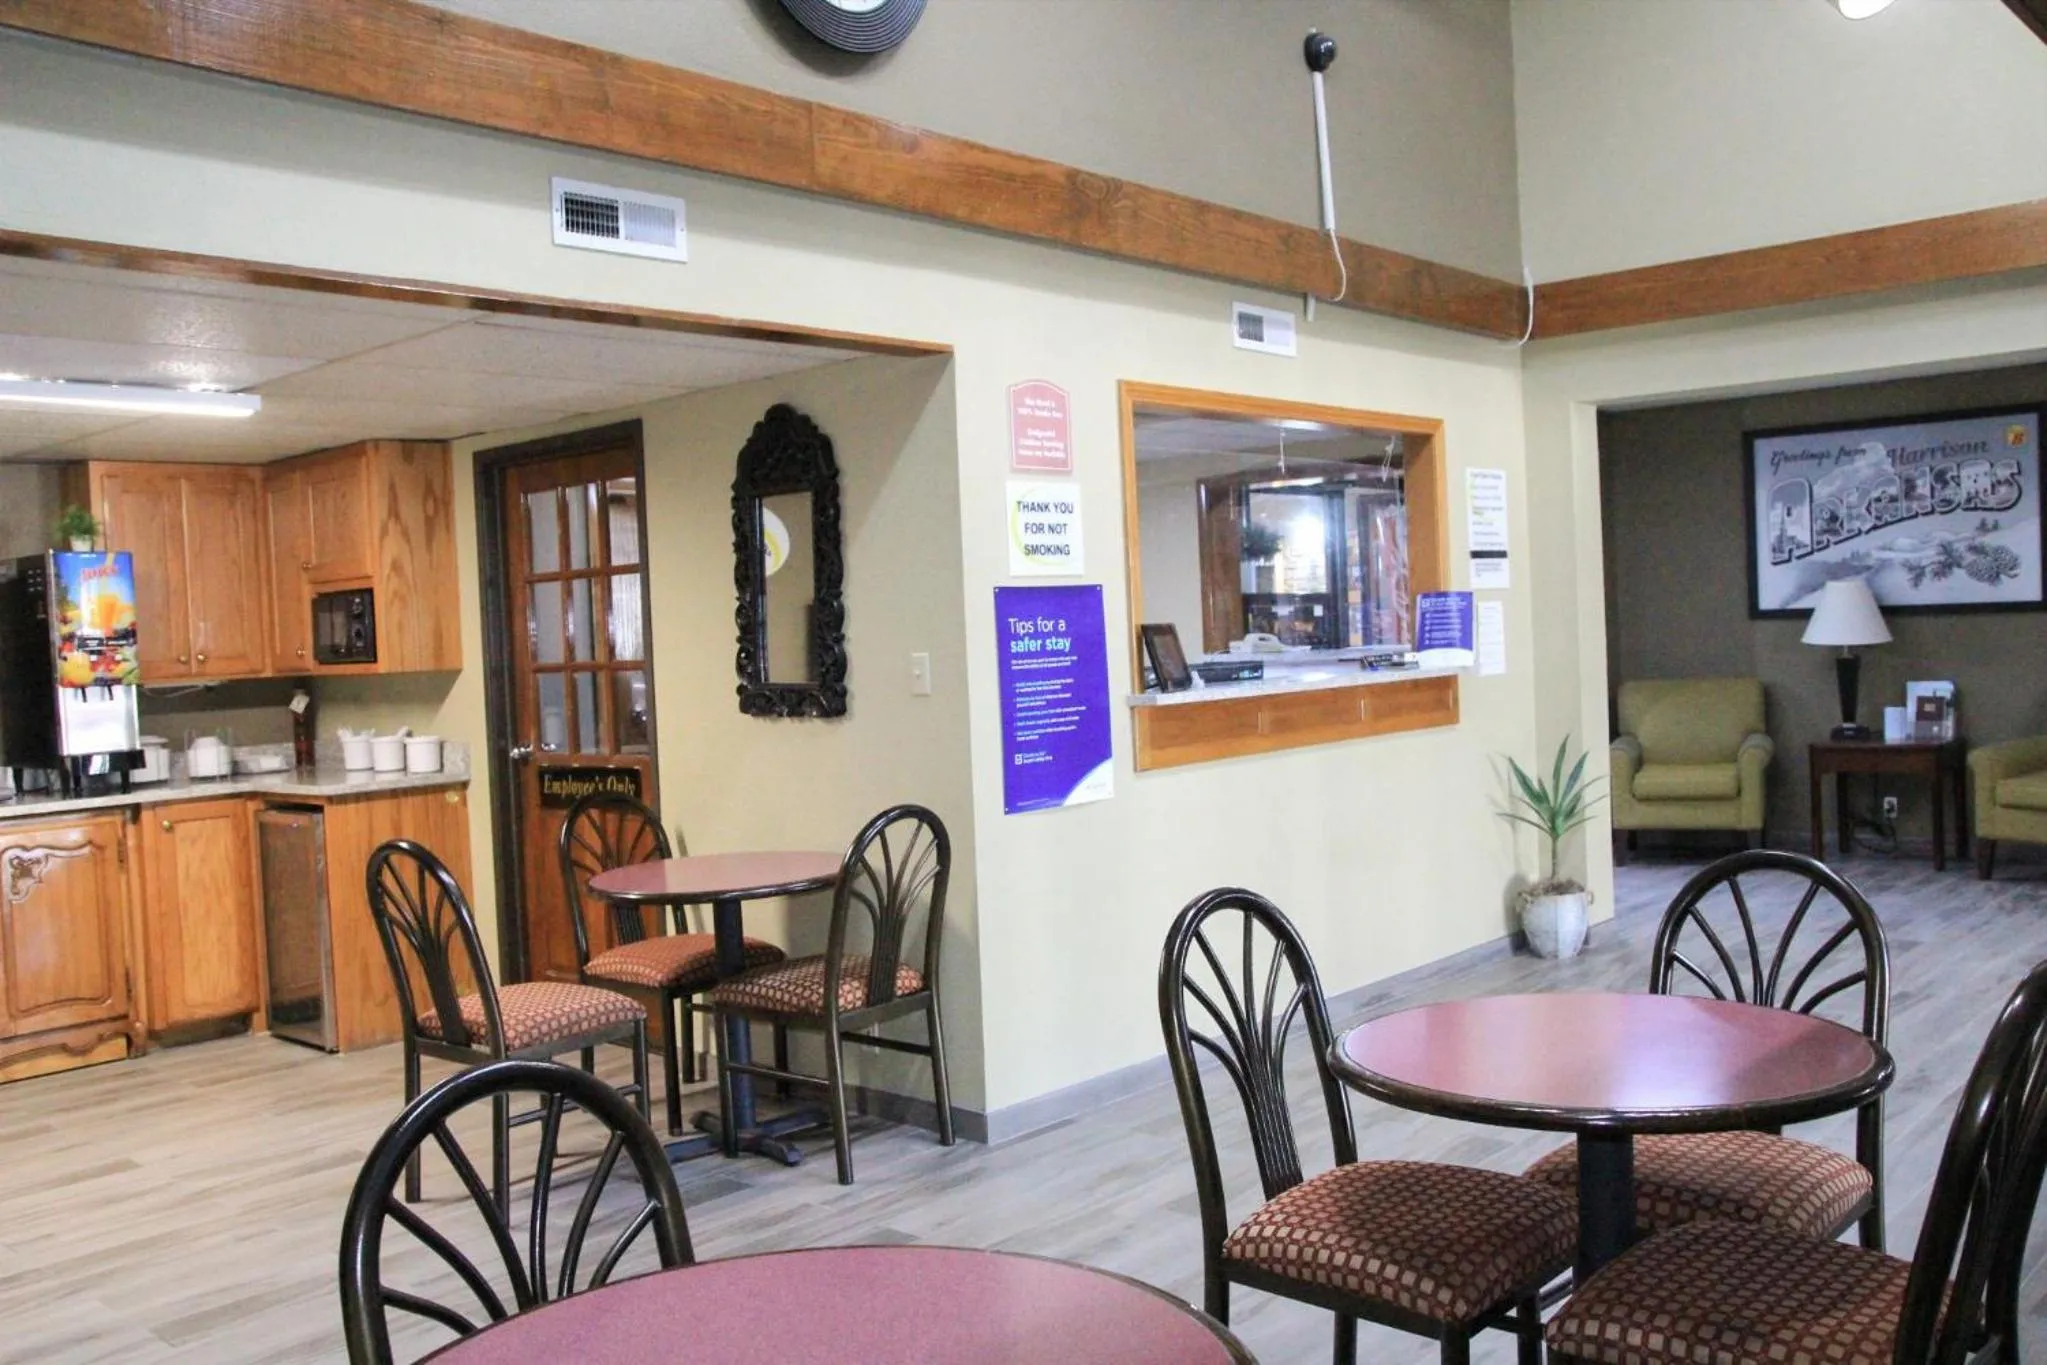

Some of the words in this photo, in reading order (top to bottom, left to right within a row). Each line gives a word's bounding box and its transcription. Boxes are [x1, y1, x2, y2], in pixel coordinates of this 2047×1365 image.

[1770, 448, 1831, 475] Greetings
[1834, 445, 1867, 466] from
[1886, 440, 1989, 468] Harrison
[1016, 500, 1051, 514] THANK
[1052, 501, 1074, 515] YOU
[1768, 458, 2023, 566] ARKANSAS
[1024, 522, 1045, 535] FOR
[1047, 523, 1068, 535] NOT
[1023, 543, 1071, 556] SMOKING
[1008, 617, 1034, 636] Tips
[1036, 616, 1055, 632] for
[1058, 619, 1066, 632] a
[1010, 636, 1042, 653] safer
[1046, 636, 1072, 652] stay
[606, 775, 636, 797] Only
